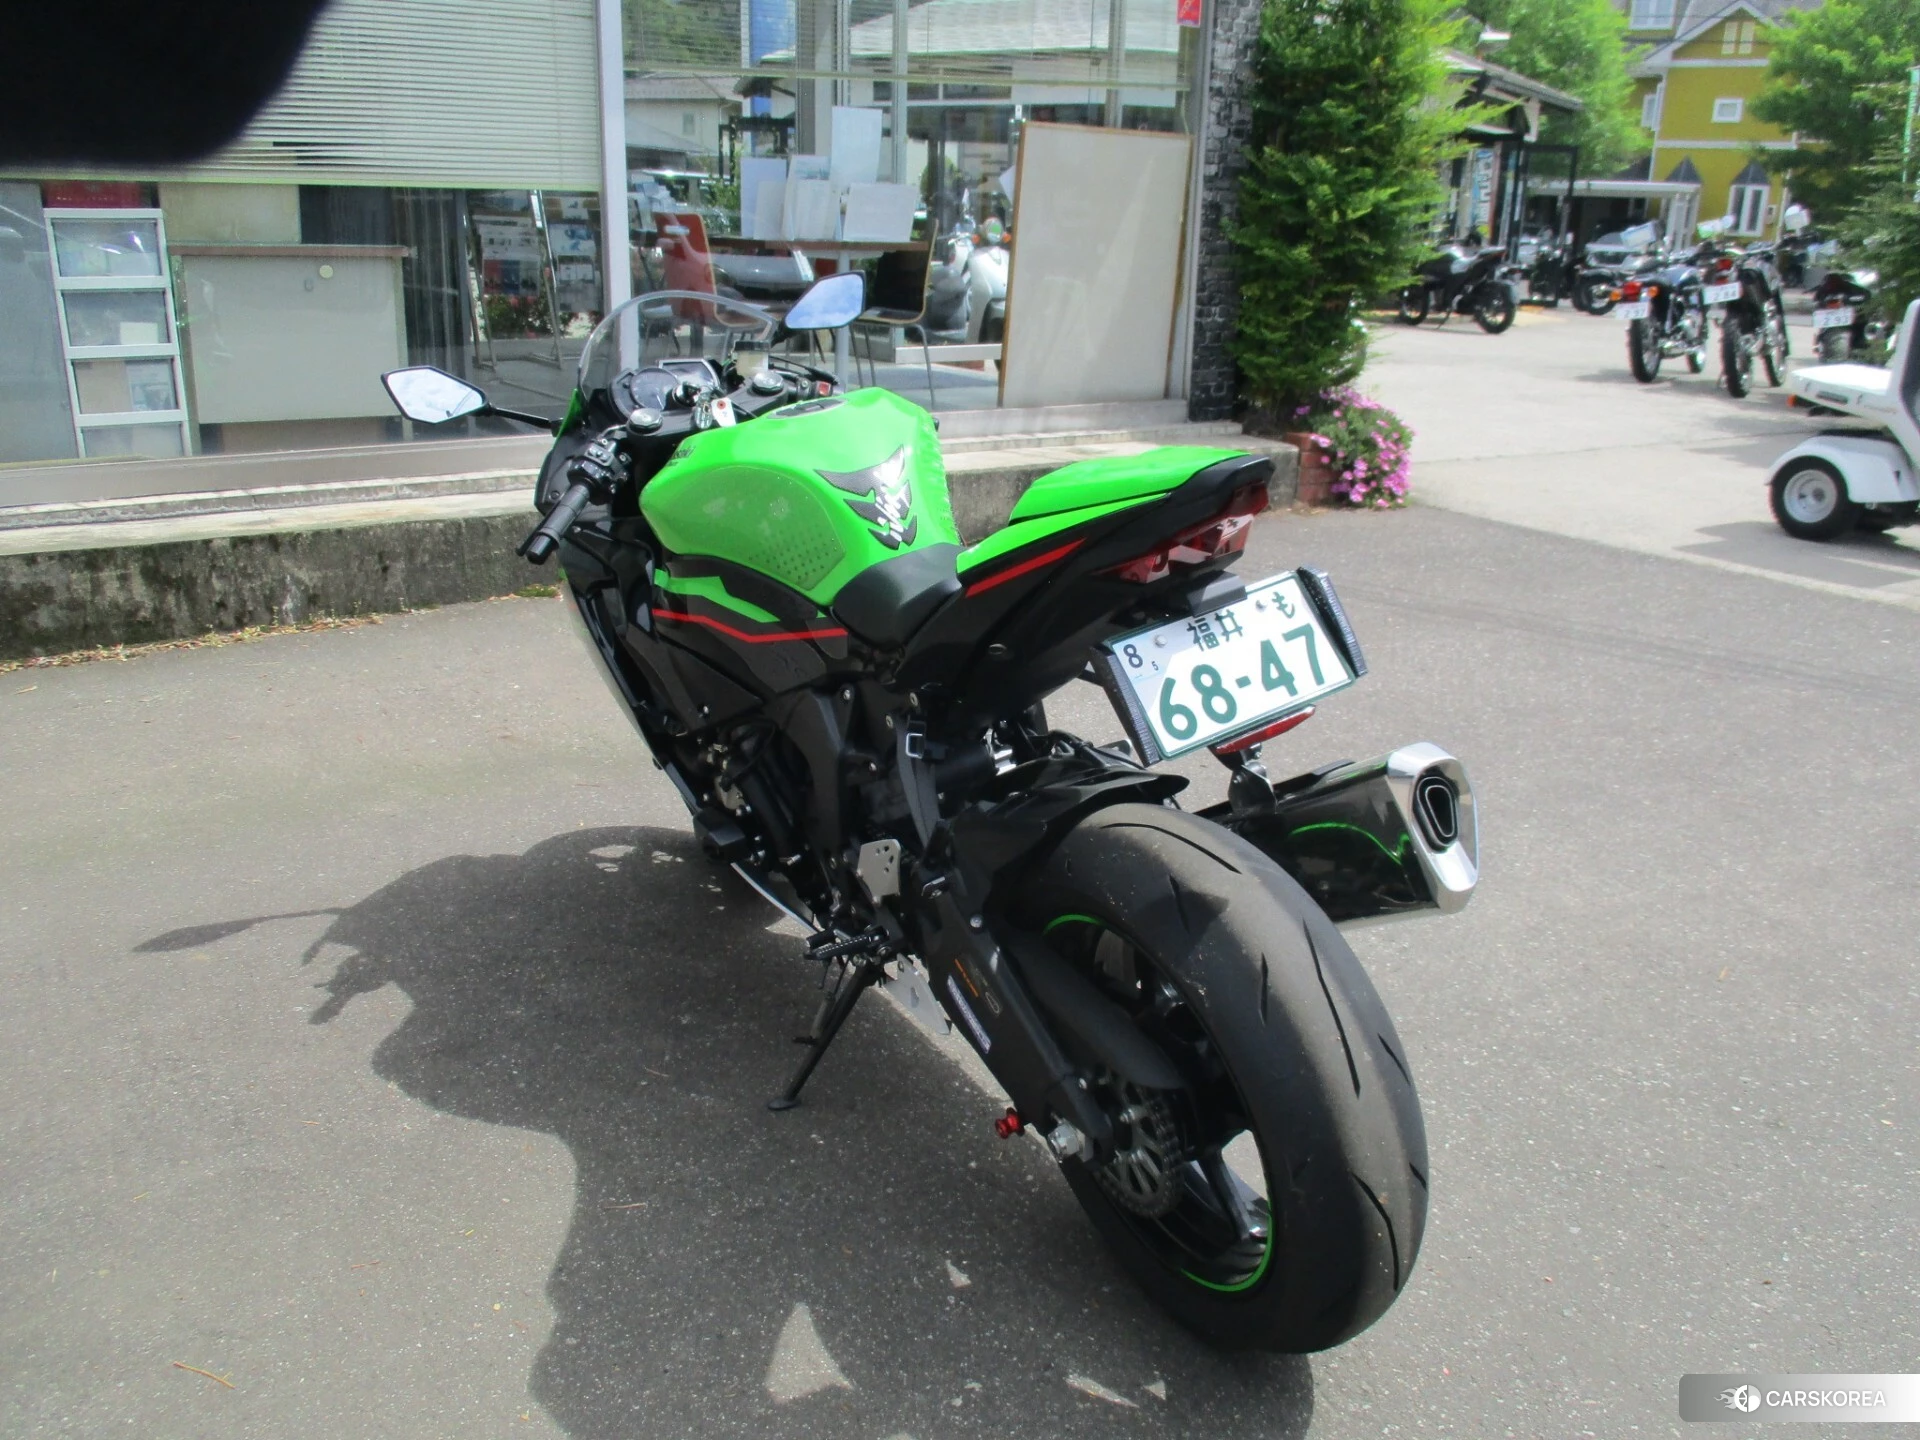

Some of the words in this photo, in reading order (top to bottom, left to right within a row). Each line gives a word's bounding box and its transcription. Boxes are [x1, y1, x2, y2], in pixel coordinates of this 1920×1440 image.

[1187, 609, 1244, 652] 福井
[1272, 592, 1296, 619] も
[1123, 643, 1143, 669] 8
[1159, 623, 1325, 741] 68-47
